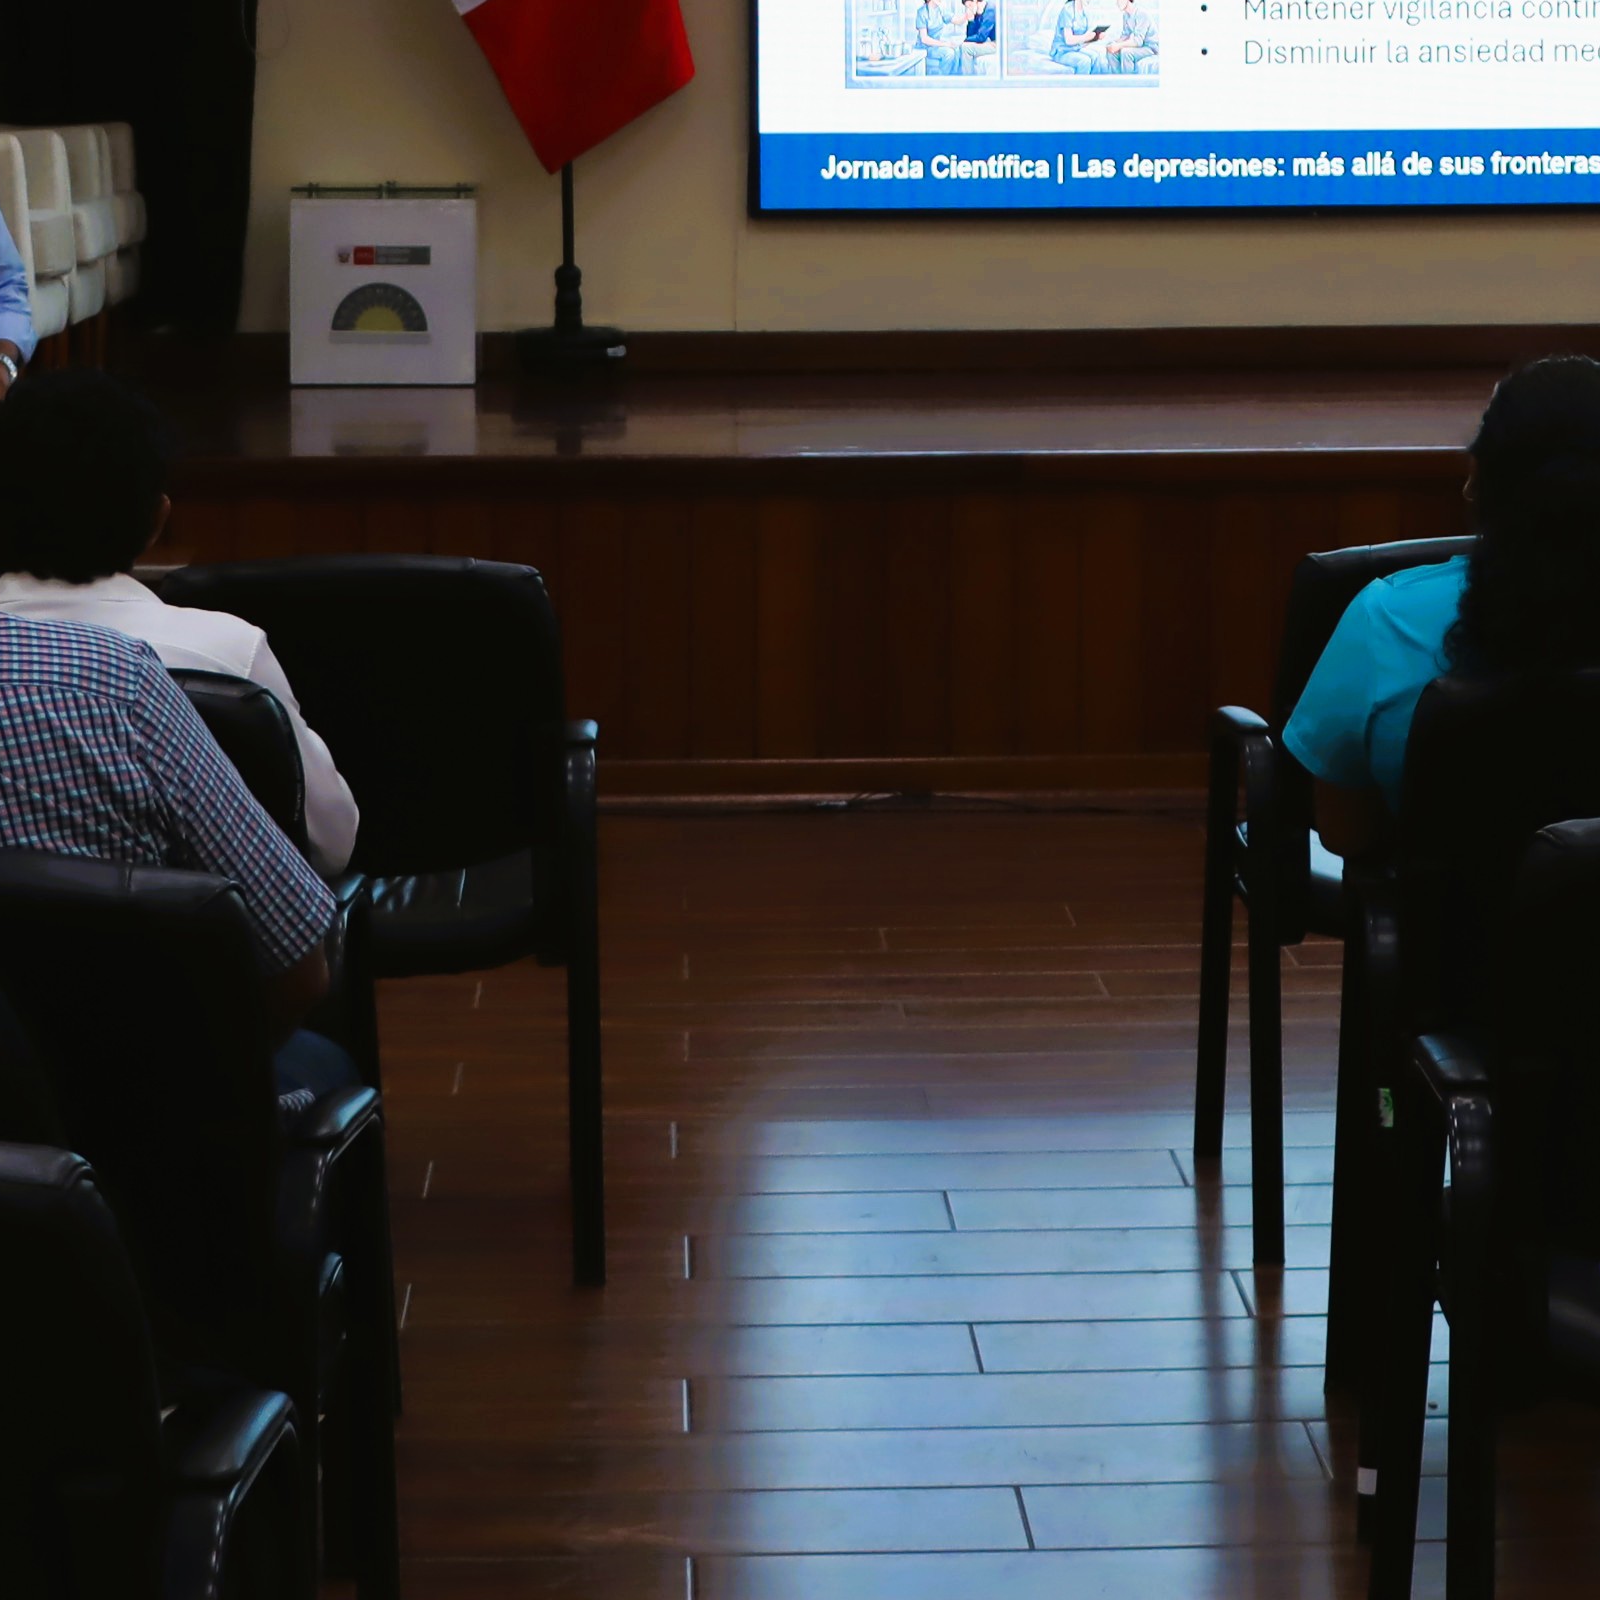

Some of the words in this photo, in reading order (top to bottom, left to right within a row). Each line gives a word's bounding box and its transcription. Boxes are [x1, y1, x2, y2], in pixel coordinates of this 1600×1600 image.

[820, 154, 924, 180] Jornada
[930, 153, 1050, 180] Científica
[1071, 153, 1117, 179] Las
[1122, 152, 1285, 184] depresiones:
[1292, 151, 1345, 177] más
[1350, 150, 1397, 177] allá
[1401, 150, 1433, 176] de
[1439, 155, 1485, 176] sus
